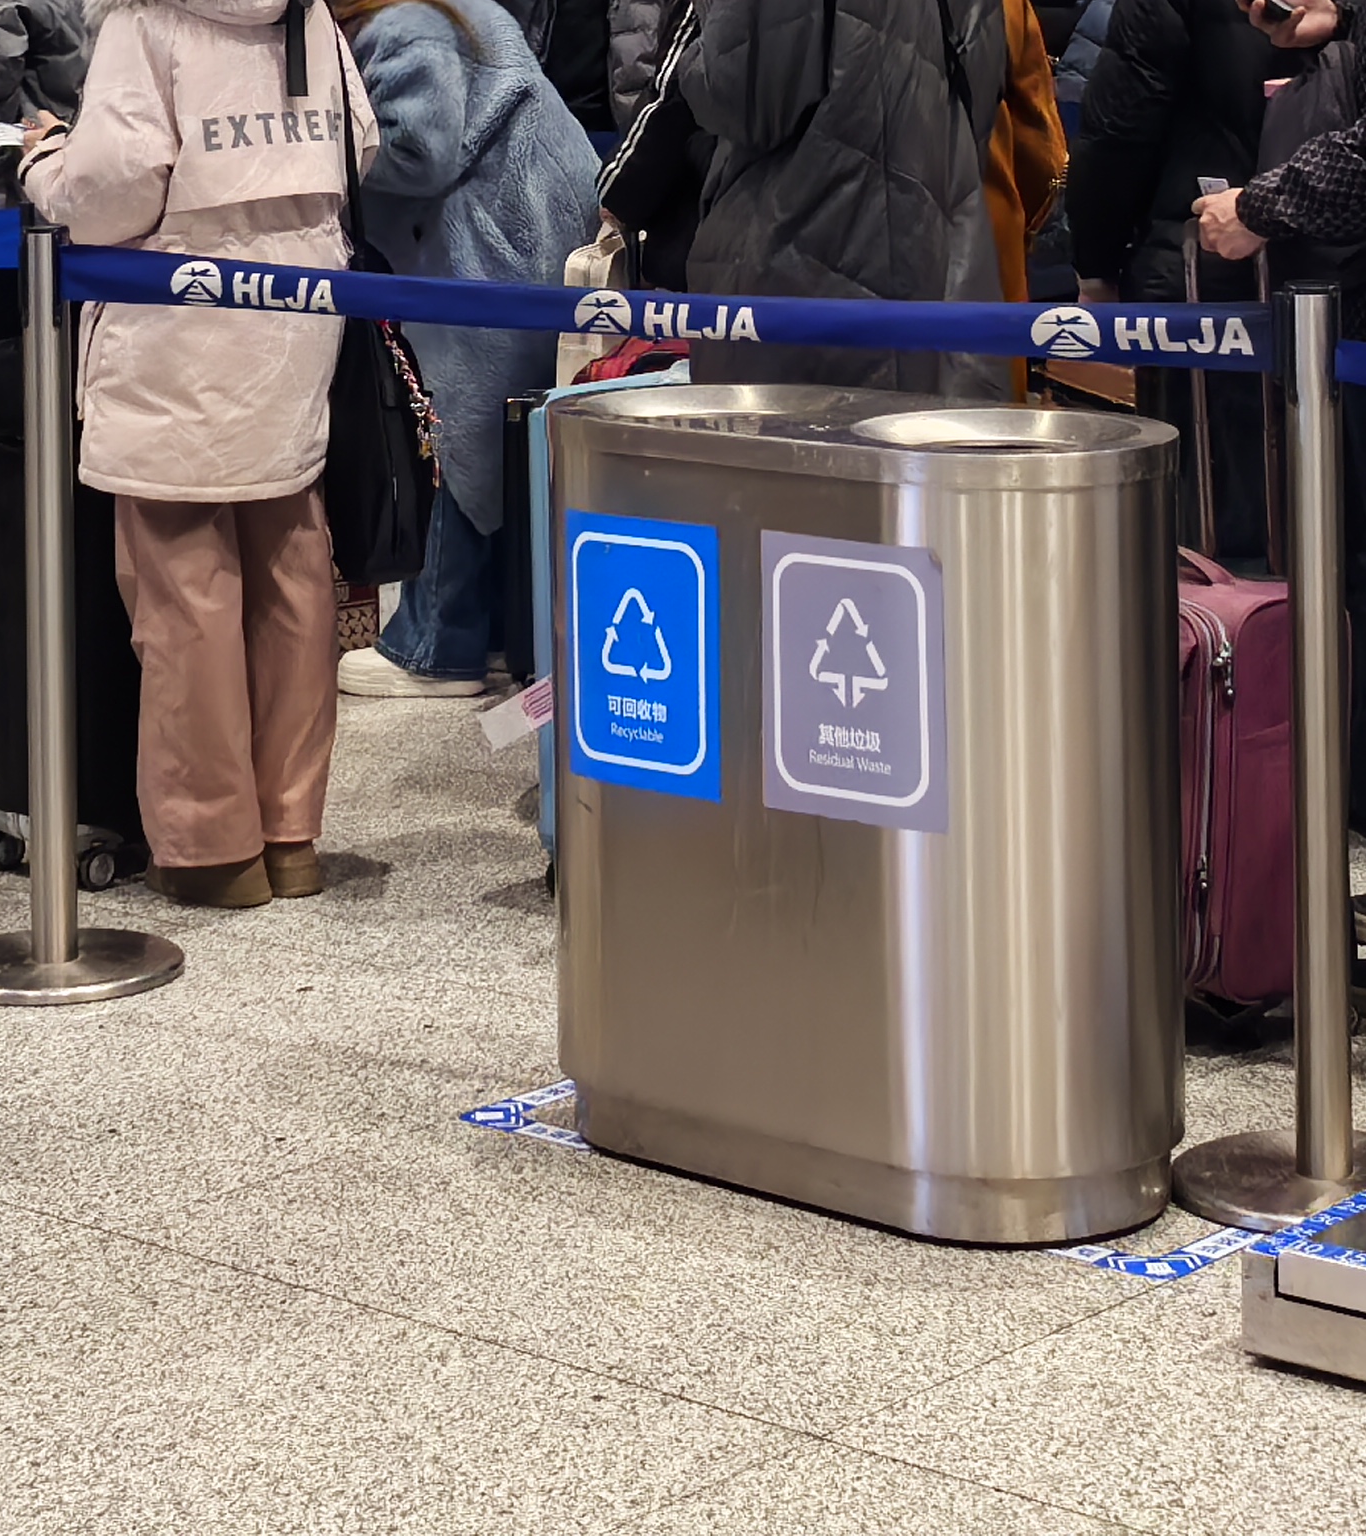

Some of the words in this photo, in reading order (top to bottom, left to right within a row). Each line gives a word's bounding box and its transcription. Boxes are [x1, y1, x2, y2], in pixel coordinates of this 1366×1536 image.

[232, 269, 336, 314] HLJA
[642, 301, 763, 343] HLJA
[1114, 316, 1255, 357] HLJA
[606, 694, 668, 724] 可回收物
[610, 720, 665, 745] Recyclable
[818, 723, 883, 754] 其他垃圾
[808, 748, 856, 773] Residual
[857, 755, 892, 777] Waste
